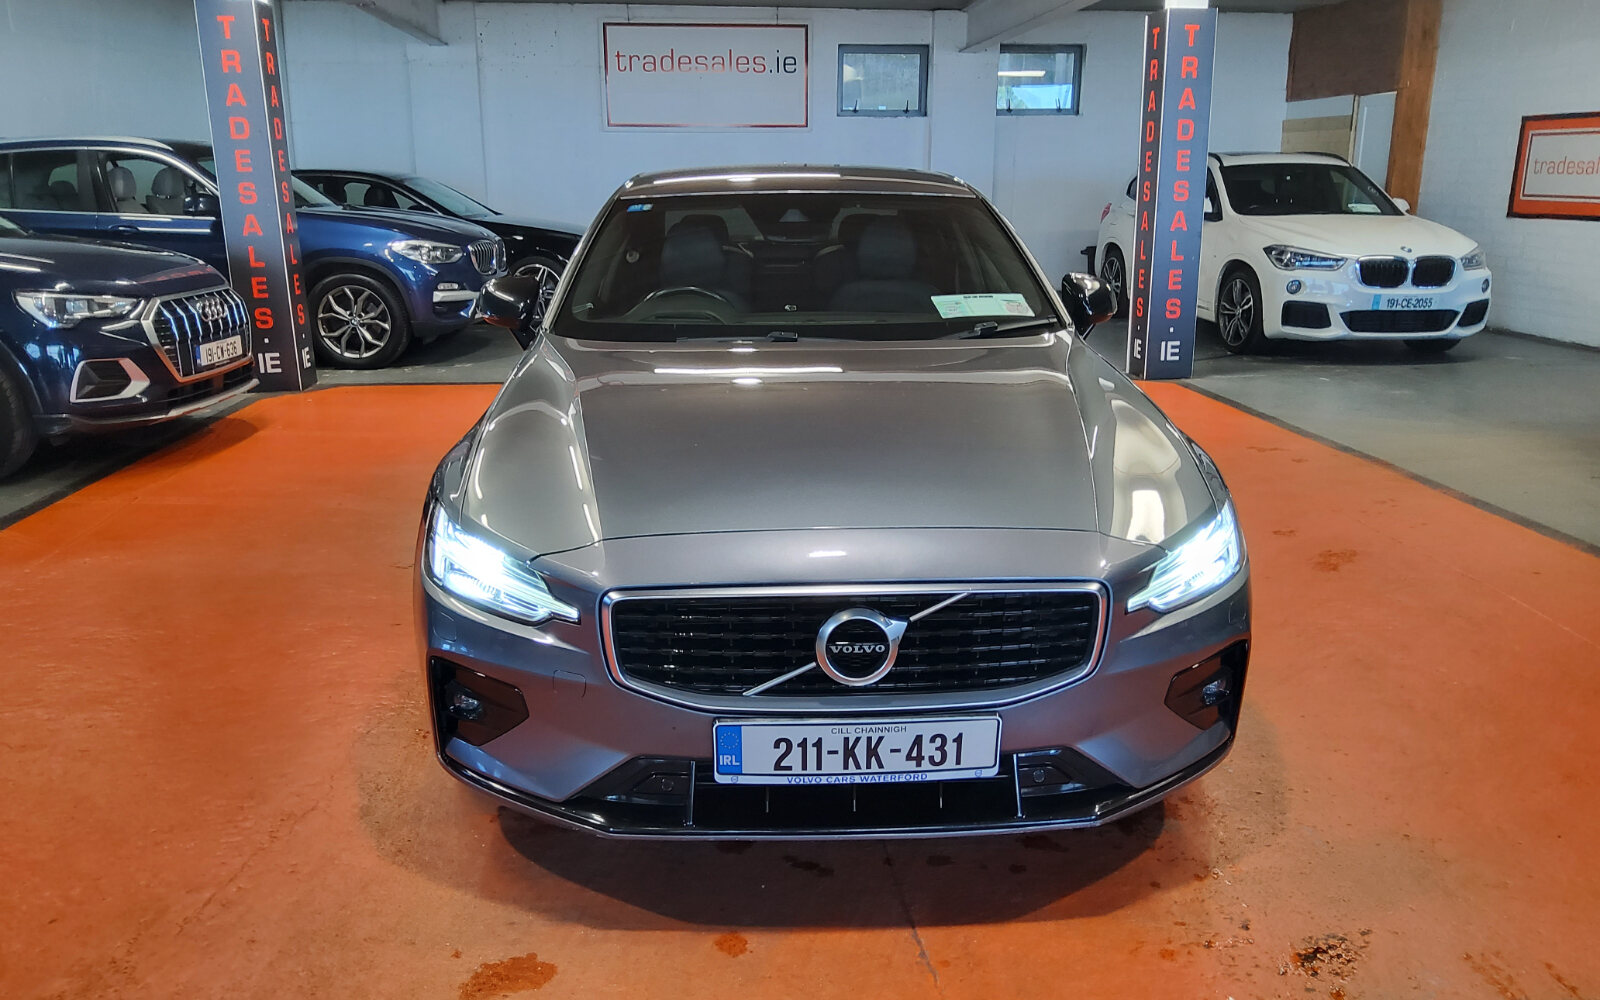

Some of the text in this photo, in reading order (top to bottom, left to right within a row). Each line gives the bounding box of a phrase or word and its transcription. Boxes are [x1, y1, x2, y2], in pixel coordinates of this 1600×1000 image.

[615, 48, 797, 74] tradesales.ie
[1386, 298, 1433, 309] 191-CE-2055
[829, 644, 886, 654] VOLVO
[831, 725, 907, 735] CILL CHAINNIGH
[773, 732, 964, 772] 211-KK-431
[719, 754, 740, 767] IRL
[787, 772, 928, 785] VOLVO CARS WATERFORD
